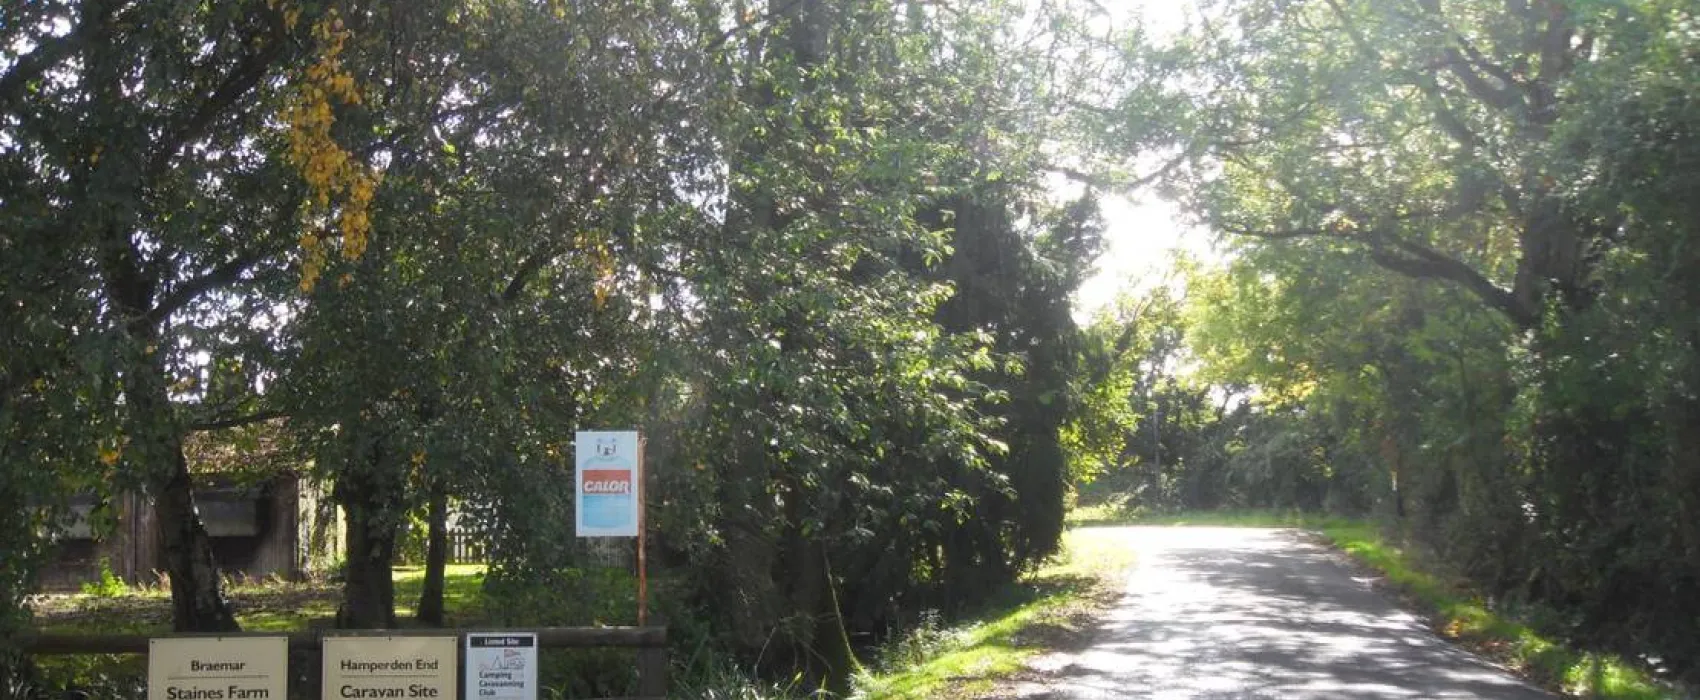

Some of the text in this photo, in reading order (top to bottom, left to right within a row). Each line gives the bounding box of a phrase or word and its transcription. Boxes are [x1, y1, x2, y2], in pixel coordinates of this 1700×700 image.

[584, 481, 629, 494] CALOR
[191, 660, 245, 671] Braemar
[341, 660, 438, 672] Hamperden End
[479, 671, 512, 680] Camping
[167, 686, 269, 700] Staines Farm
[341, 684, 438, 698] Caravan Site
[479, 688, 496, 696] Club
